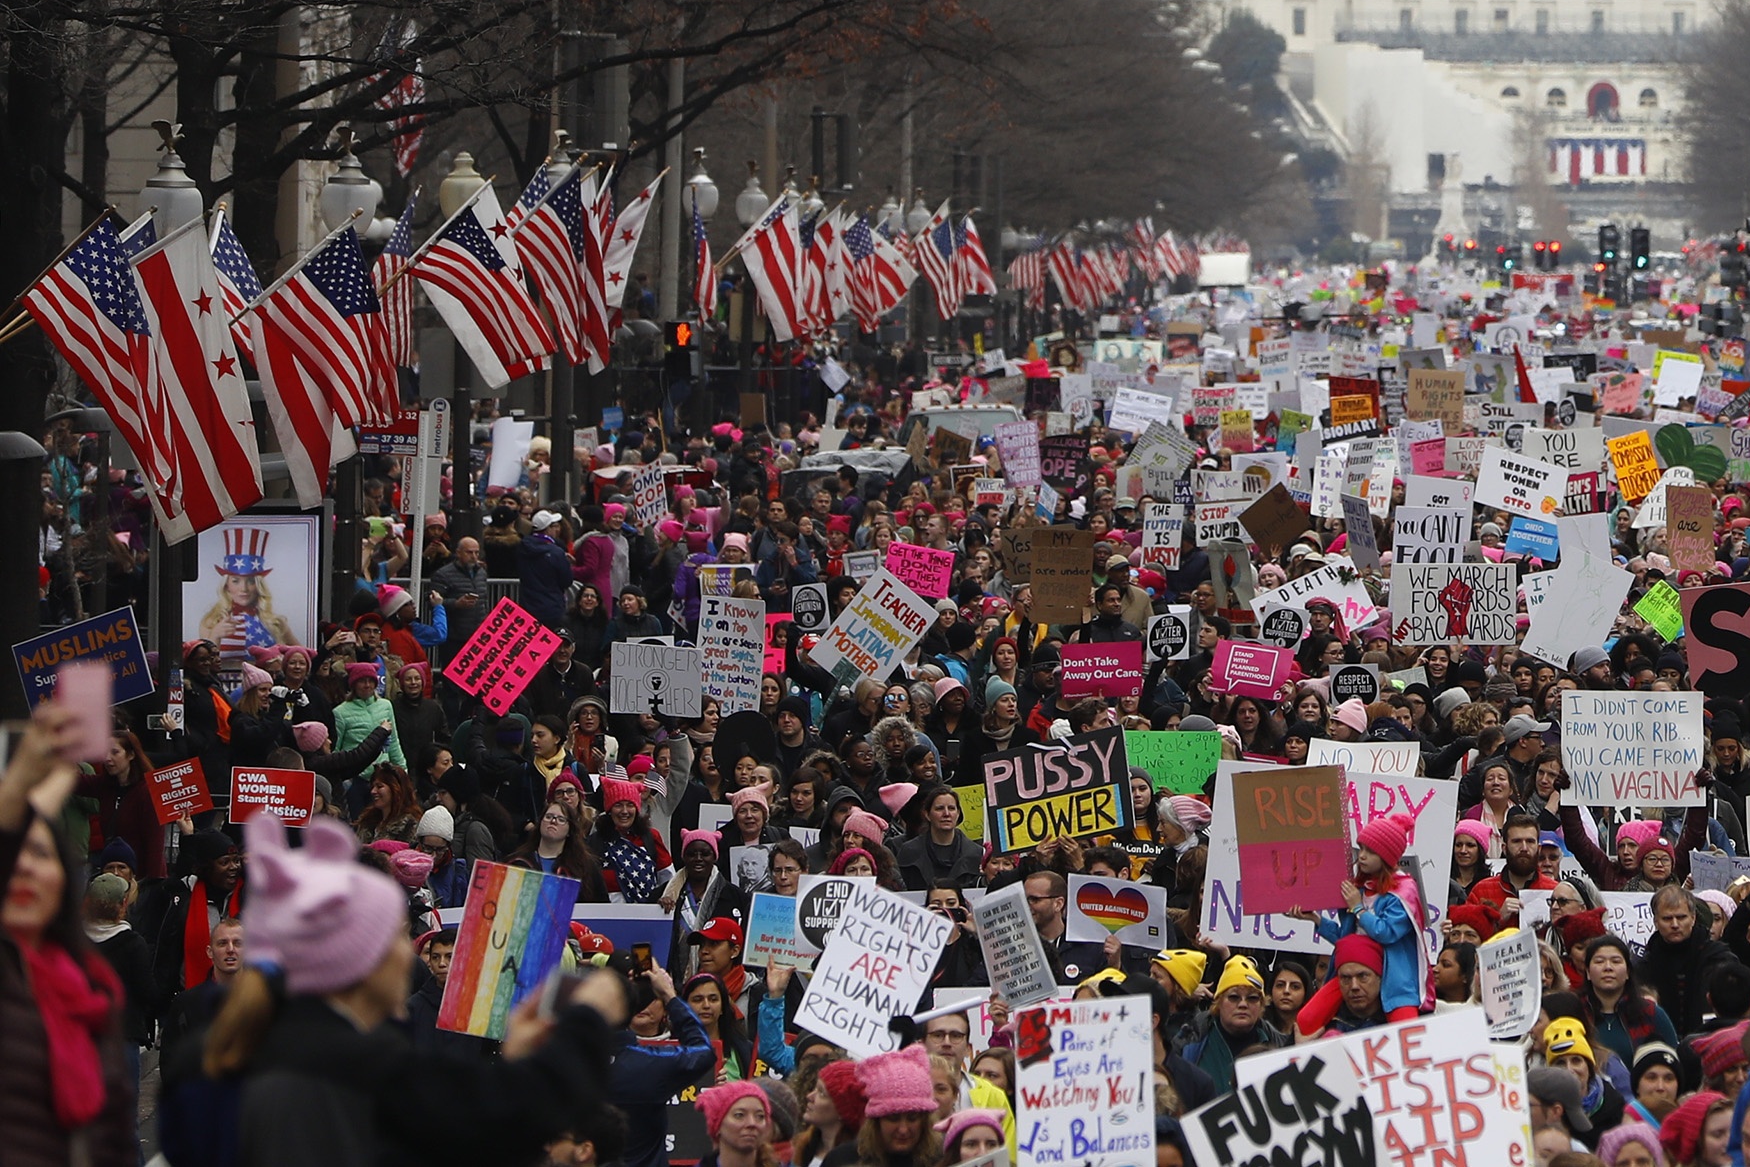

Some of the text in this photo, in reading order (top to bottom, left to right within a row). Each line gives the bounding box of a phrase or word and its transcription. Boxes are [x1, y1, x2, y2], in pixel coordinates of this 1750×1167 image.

[381, 435, 391, 443] 37
[393, 435, 404, 443] 39
[407, 436, 417, 444] A9
[1542, 432, 1576, 452] YOU
[1611, 446, 1654, 471] COMPASSION
[633, 468, 663, 493] OMG
[1500, 459, 1550, 481] RESPECT
[1503, 472, 1540, 491] WOMEN
[1512, 487, 1527, 498] OR
[635, 483, 664, 508] GOP
[1503, 496, 1532, 511] GTFO
[1151, 505, 1169, 516] THE
[1200, 505, 1230, 522] STOP
[1145, 516, 1182, 530] FUTURE
[1200, 521, 1241, 540] STUPID
[1396, 512, 1464, 544] YOU CAN'T
[1524, 522, 1544, 532] OHIO
[1677, 520, 1701, 532] are
[1155, 533, 1170, 545] IS
[1511, 531, 1554, 546] TOGETHER
[1143, 547, 1180, 569] NASTY
[1409, 566, 1508, 591] WE MARCH
[873, 578, 927, 636] TEACHER
[1160, 617, 1175, 628] END
[1392, 617, 1413, 644] NOT
[20, 618, 134, 675] MUSLIMS
[464, 615, 527, 688] IMMIGRANTS
[827, 625, 879, 677] MOTHER
[845, 618, 894, 667] LATINA
[615, 645, 699, 672] STRONGER
[1091, 657, 1119, 666] Take
[1234, 651, 1255, 659] STAND
[1063, 668, 1142, 680] Away Our Care.
[1230, 670, 1270, 681] PARENTHOOD
[1231, 663, 1260, 673] PLANNED
[1338, 674, 1370, 685] RESPECT
[1570, 695, 1690, 718] I DIDN'T COME
[1566, 721, 1690, 744] FROM YOUR RIB...
[1567, 746, 1698, 768] YOU CAME FROM
[153, 764, 194, 783] UNIONS
[237, 773, 268, 784] CWA
[984, 736, 1117, 807] PUSSY
[160, 784, 199, 802] RIGHTS
[237, 783, 286, 795] WOMEN
[237, 794, 286, 804] Stand for
[173, 800, 194, 811] CWA
[1255, 785, 1336, 829] RISE
[1006, 790, 1117, 846] POWER
[1271, 849, 1323, 889] UP
[853, 884, 953, 952] WOMEN'S
[1081, 902, 1145, 919] UNITED AGAINST HATE
[839, 916, 932, 974] RIGHTS
[850, 952, 903, 990] ARE
[821, 971, 910, 1016] HUMAN
[803, 991, 896, 1053] RIGHTS
[1200, 1055, 1340, 1166] FUCK
[1035, 1117, 1150, 1163] and Balances
